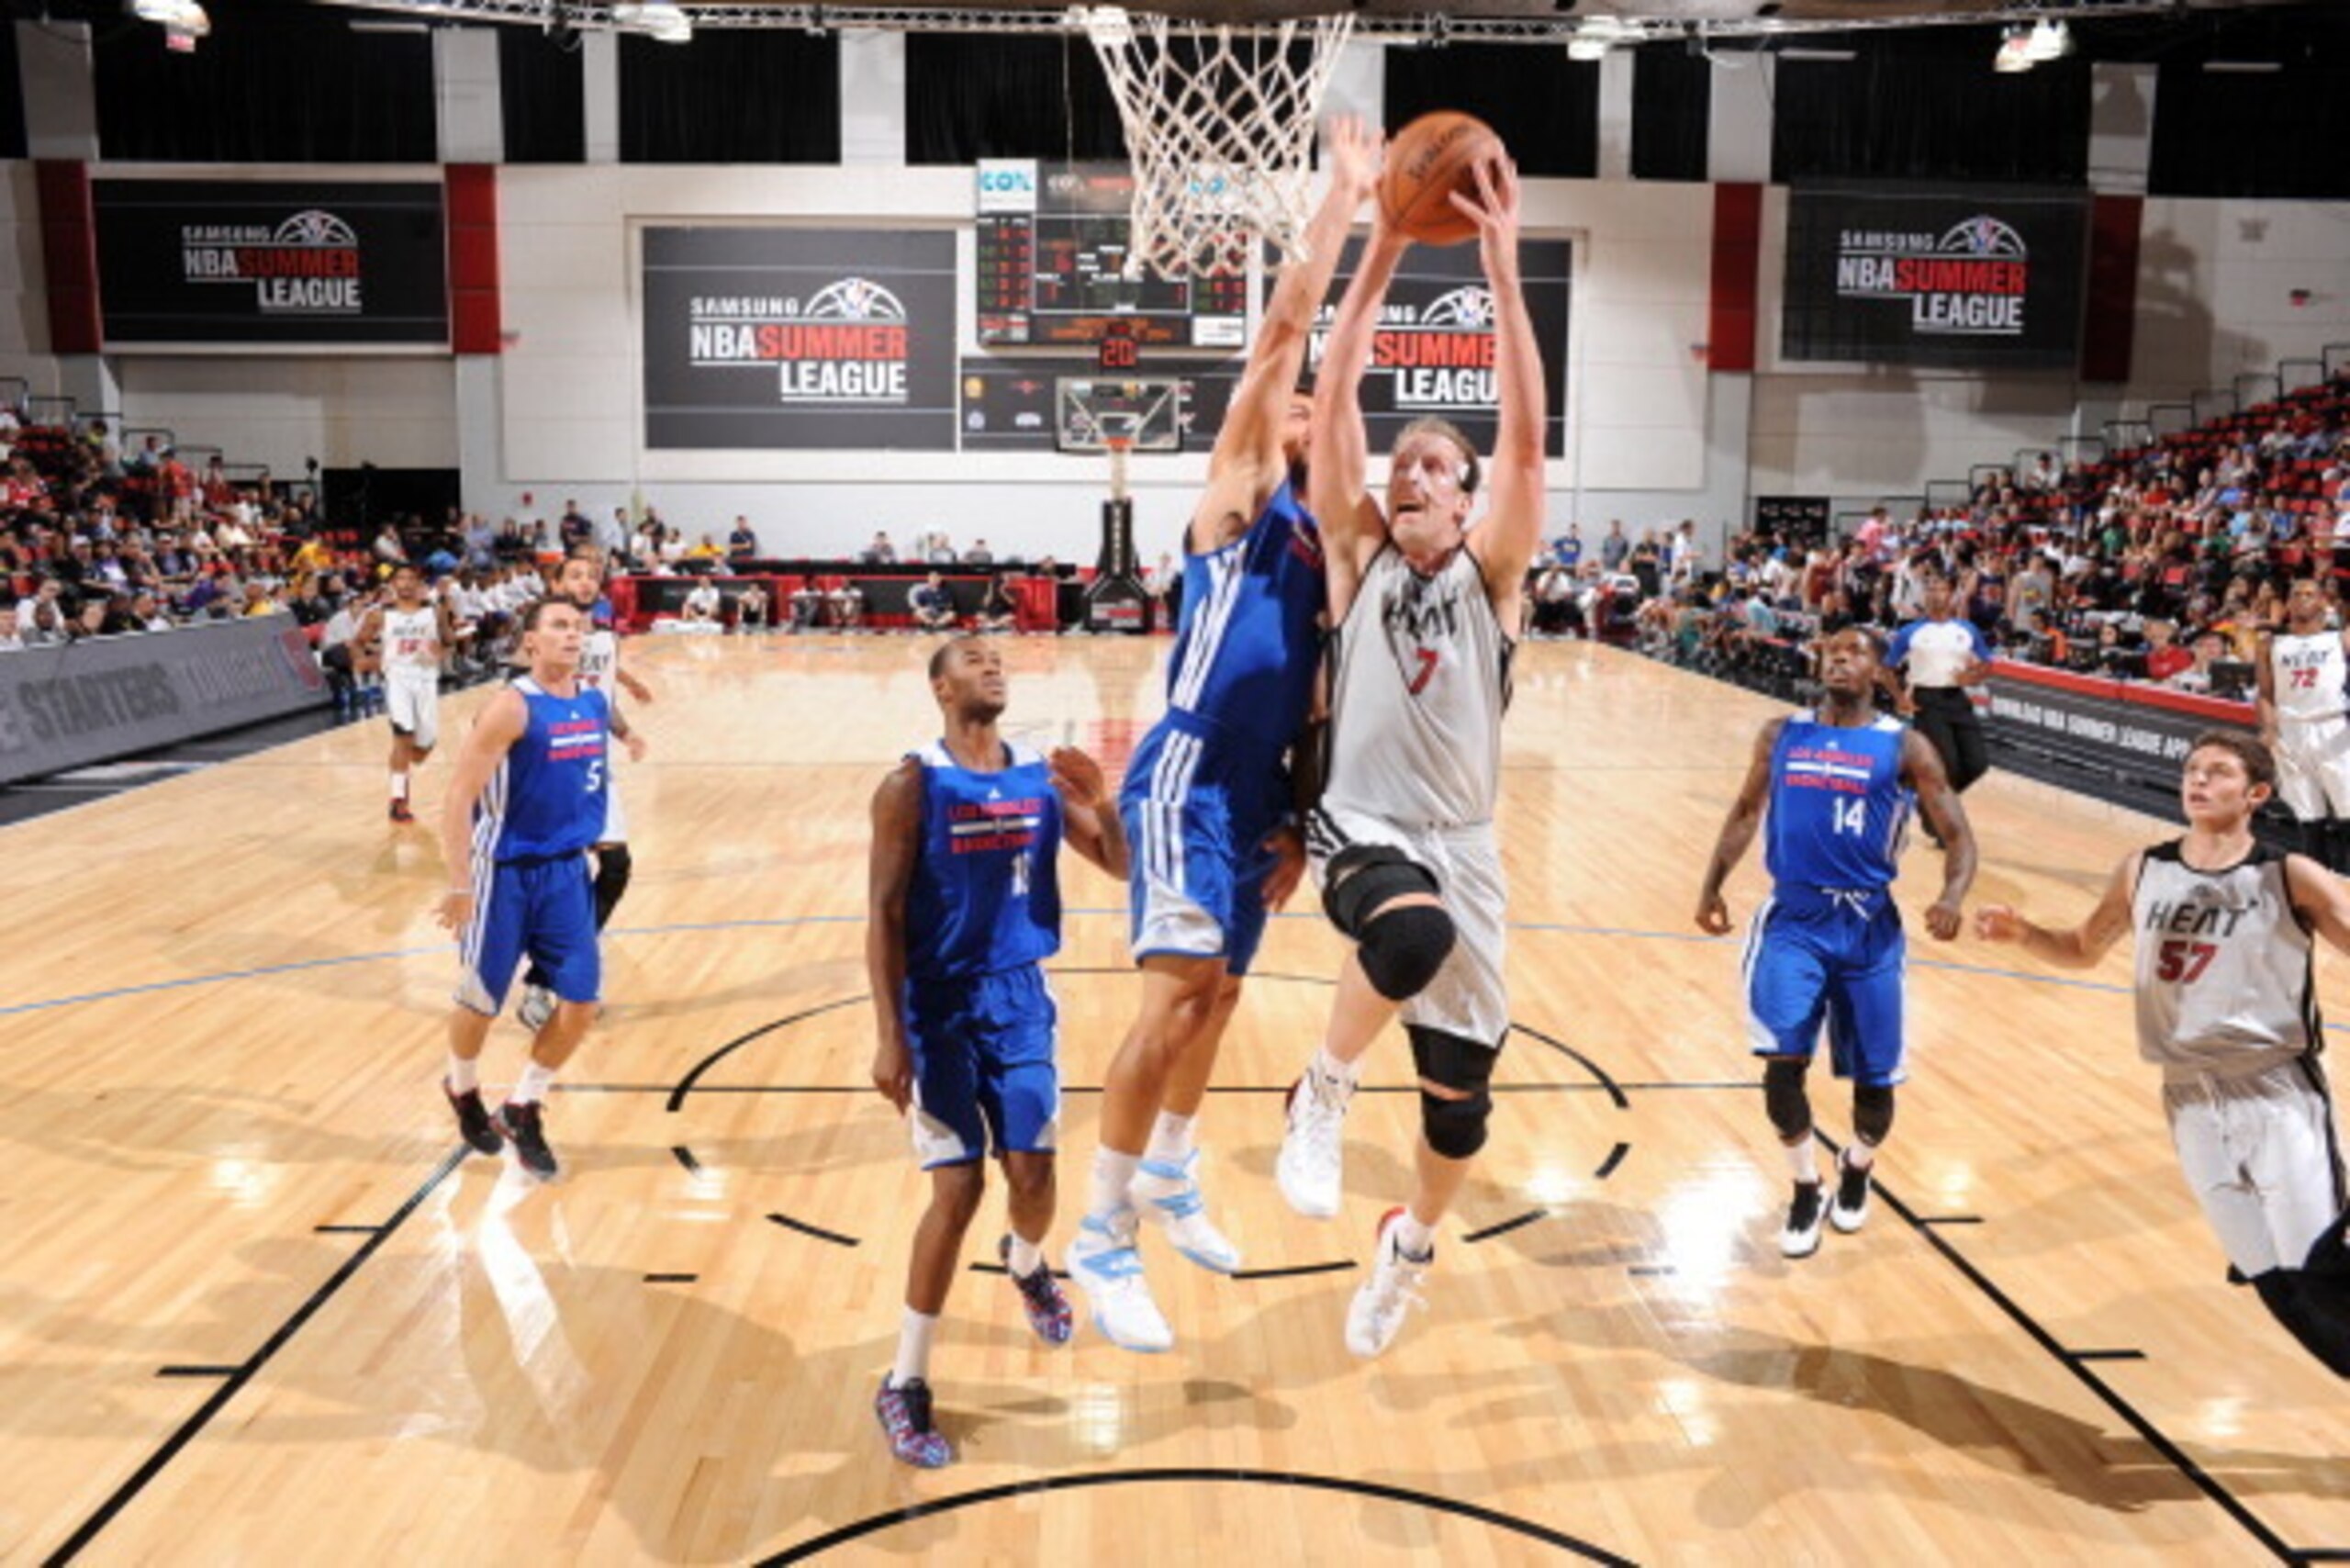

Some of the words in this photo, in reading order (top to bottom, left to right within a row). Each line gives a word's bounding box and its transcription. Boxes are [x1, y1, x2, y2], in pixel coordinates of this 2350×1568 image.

[183, 226, 271, 241] SAMSUNG
[1841, 230, 1933, 250] SAMSUNG
[185, 248, 239, 275] NBA
[238, 249, 358, 277] SUMMER
[1838, 256, 1895, 289] NBA
[1895, 258, 2027, 293] SUMMER
[257, 278, 362, 307] LEAGUE
[690, 297, 799, 314] SAMSUNG
[1913, 294, 2024, 326] LEAGUE
[690, 325, 758, 358] NBA
[757, 325, 907, 359] SUMMER
[1102, 339, 1136, 366] 20
[1374, 332, 1496, 366] SUMME
[780, 362, 907, 394] LEAGUE
[1396, 369, 1498, 402] LEAGU
[1409, 646, 1438, 696] 7
[2290, 666, 2320, 689] 72
[17, 662, 180, 739] STARTERS
[586, 760, 602, 792] 5
[1833, 796, 1865, 837] 14
[2145, 901, 2247, 937] HEAT
[2156, 939, 2220, 984] 57
